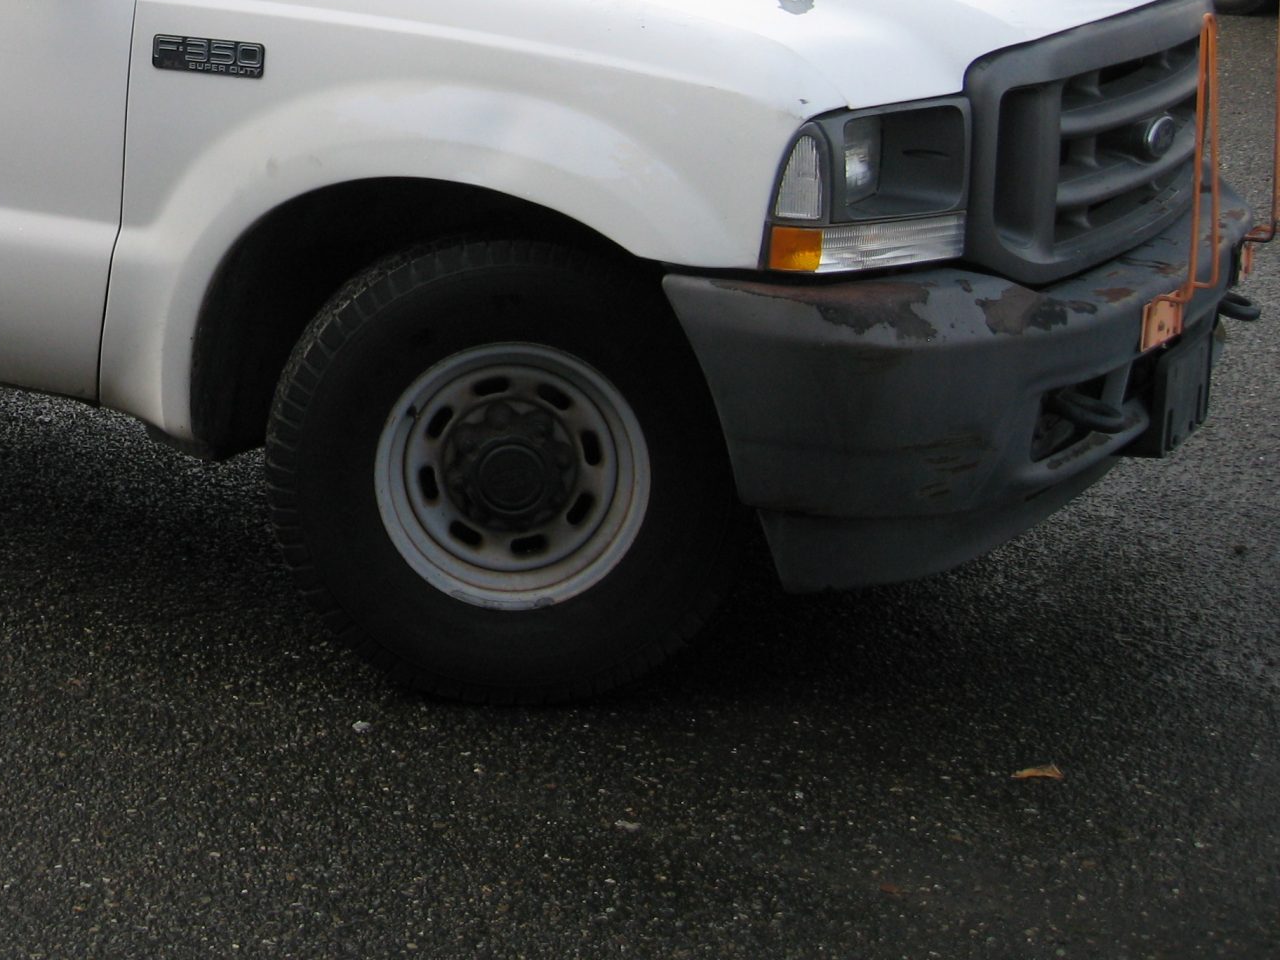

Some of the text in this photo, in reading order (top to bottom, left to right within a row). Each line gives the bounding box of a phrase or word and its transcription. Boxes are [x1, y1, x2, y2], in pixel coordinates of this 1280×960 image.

[153, 35, 262, 67] F-350
[188, 62, 226, 72] SUPER
[229, 66, 262, 75] DUTY
